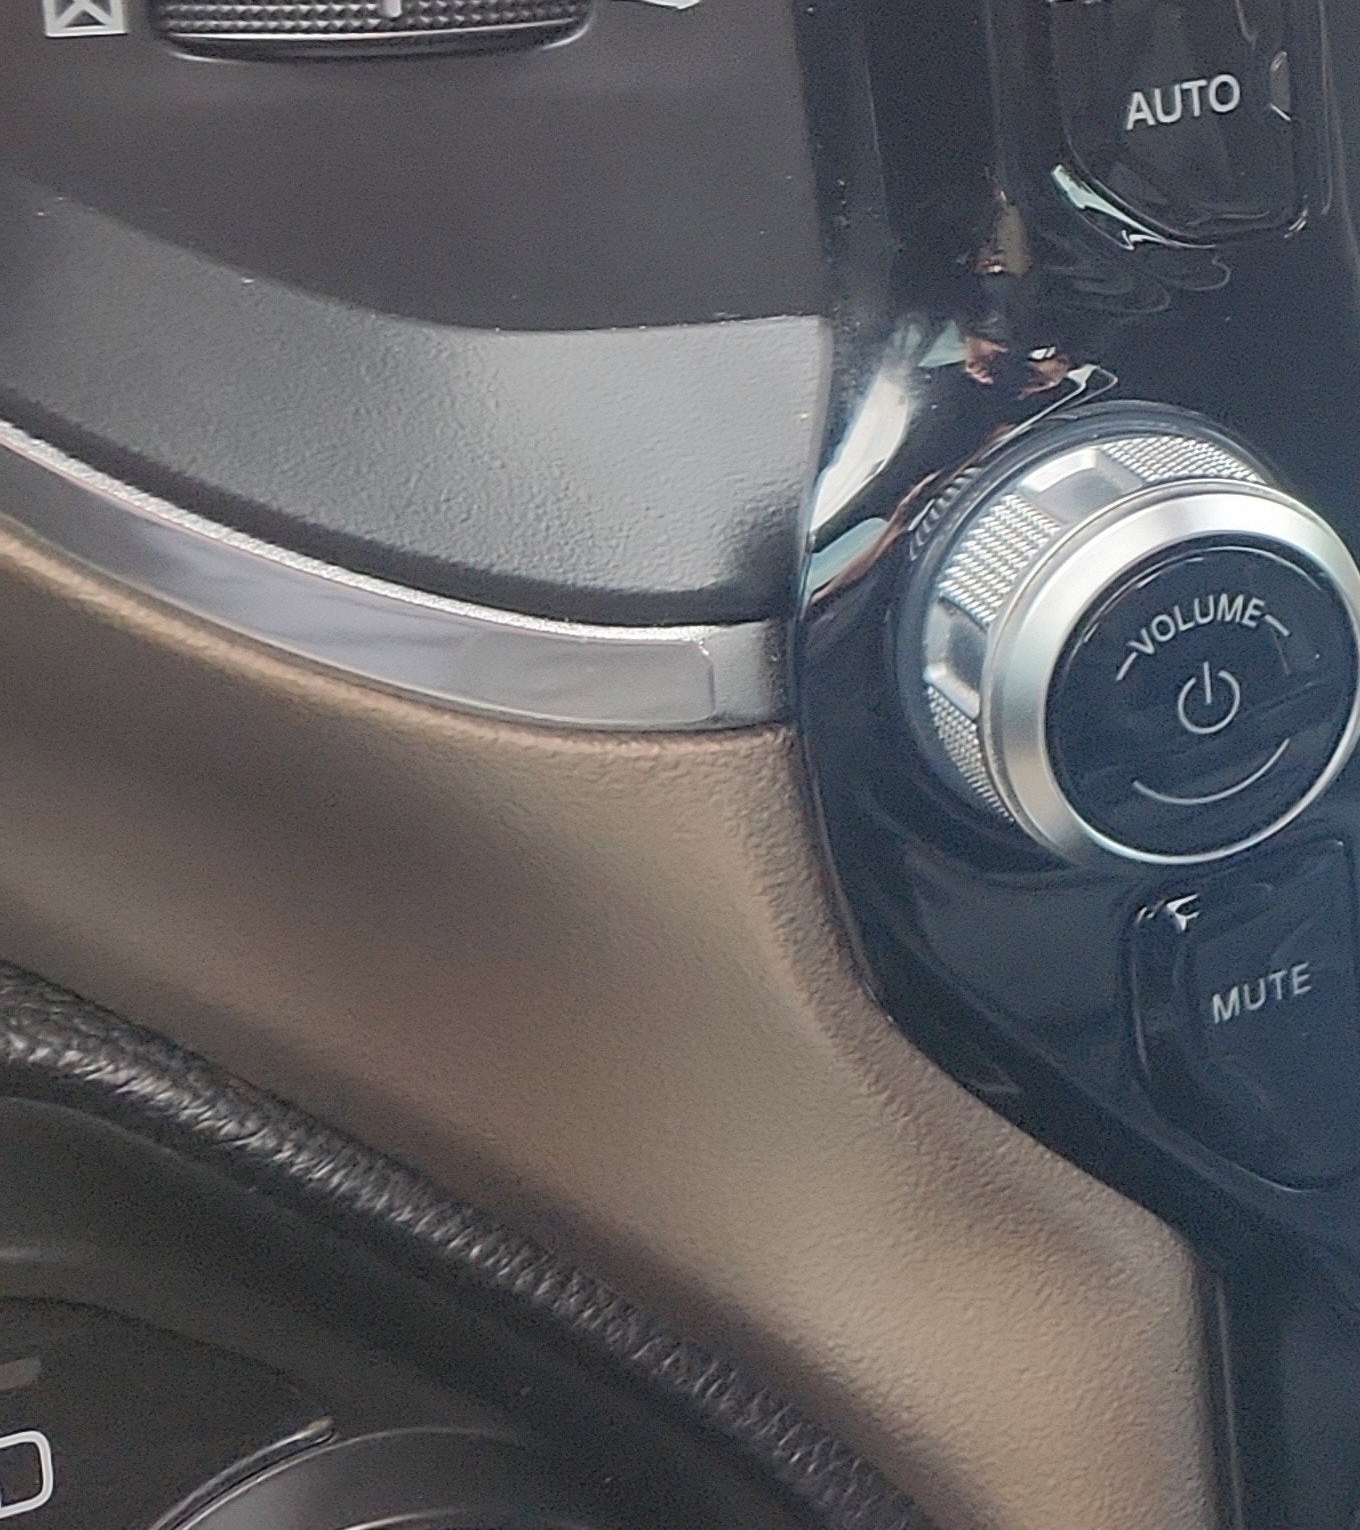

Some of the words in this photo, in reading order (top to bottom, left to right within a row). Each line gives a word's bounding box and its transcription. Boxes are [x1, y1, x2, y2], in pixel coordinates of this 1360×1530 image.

[1126, 73, 1241, 131] AUTO
[1128, 592, 1266, 658] VOLUME
[1212, 962, 1312, 1024] MUTE
